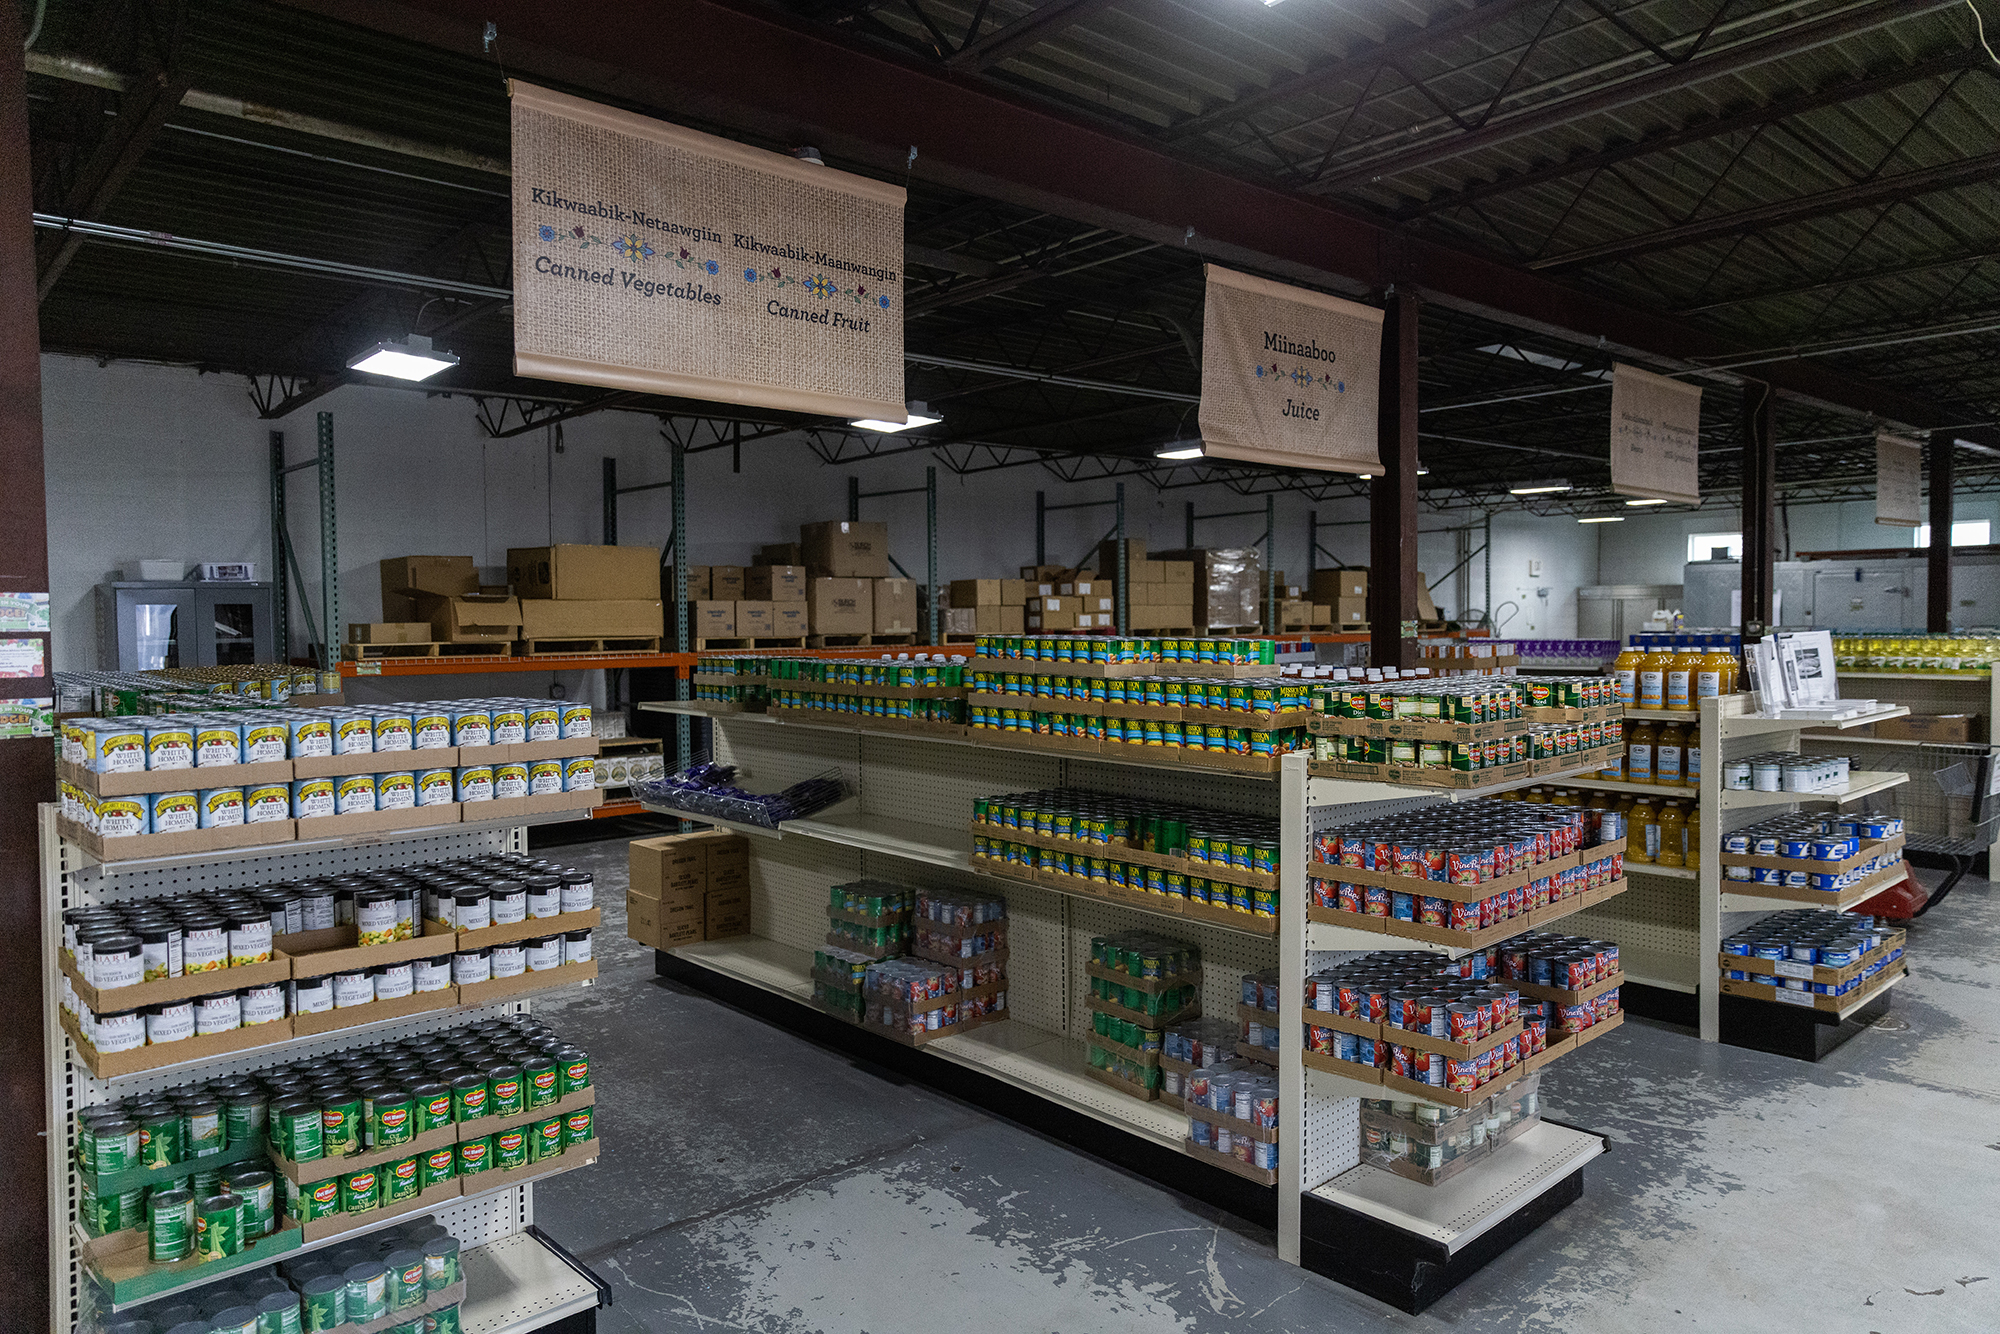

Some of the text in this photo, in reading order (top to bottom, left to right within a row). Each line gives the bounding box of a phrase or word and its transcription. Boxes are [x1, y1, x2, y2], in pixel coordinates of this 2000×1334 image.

[531, 187, 723, 245] Kikwaabik-Netaawgiin
[733, 233, 897, 284] Kikwaabik-Maanwangin
[534, 256, 723, 306] Canned Vegetables
[766, 300, 871, 333] Canned Fruit
[1264, 331, 1336, 363] Miinaaboo
[1282, 399, 1320, 421] Juice
[1280, 686, 1299, 695] MISSION
[14, 706, 34, 715] YOUR
[160, 749, 187, 757] WHITE
[202, 752, 233, 760] HOMINY
[205, 747, 231, 755] WHITE
[157, 754, 189, 762] HOMINY
[256, 808, 287, 816] HOMINY
[259, 803, 284, 811] WHITE
[168, 812, 192, 820] WHITE
[103, 823, 135, 831] HOMINY
[105, 818, 131, 826] WHITE
[1394, 851, 1413, 863] Vine
[1453, 860, 1471, 870] Vine
[369, 900, 396, 911] HART
[1457, 907, 1474, 918] Vine
[242, 921, 271, 933] HART
[189, 929, 221, 940] HART
[493, 948, 518, 956] HART
[95, 953, 127, 965] HART
[105, 971, 141, 983] VEGETABLES
[335, 974, 362, 983] HART
[250, 986, 280, 998] HART
[204, 997, 236, 1009] HART
[101, 1014, 135, 1027] HART
[1456, 1017, 1472, 1028] Vine
[1314, 1029, 1330, 1040] Vine
[1450, 1063, 1469, 1074] Vine
[439, 1154, 451, 1162] Monte
[360, 1177, 374, 1185] Monte
[325, 1187, 336, 1195] Monte
